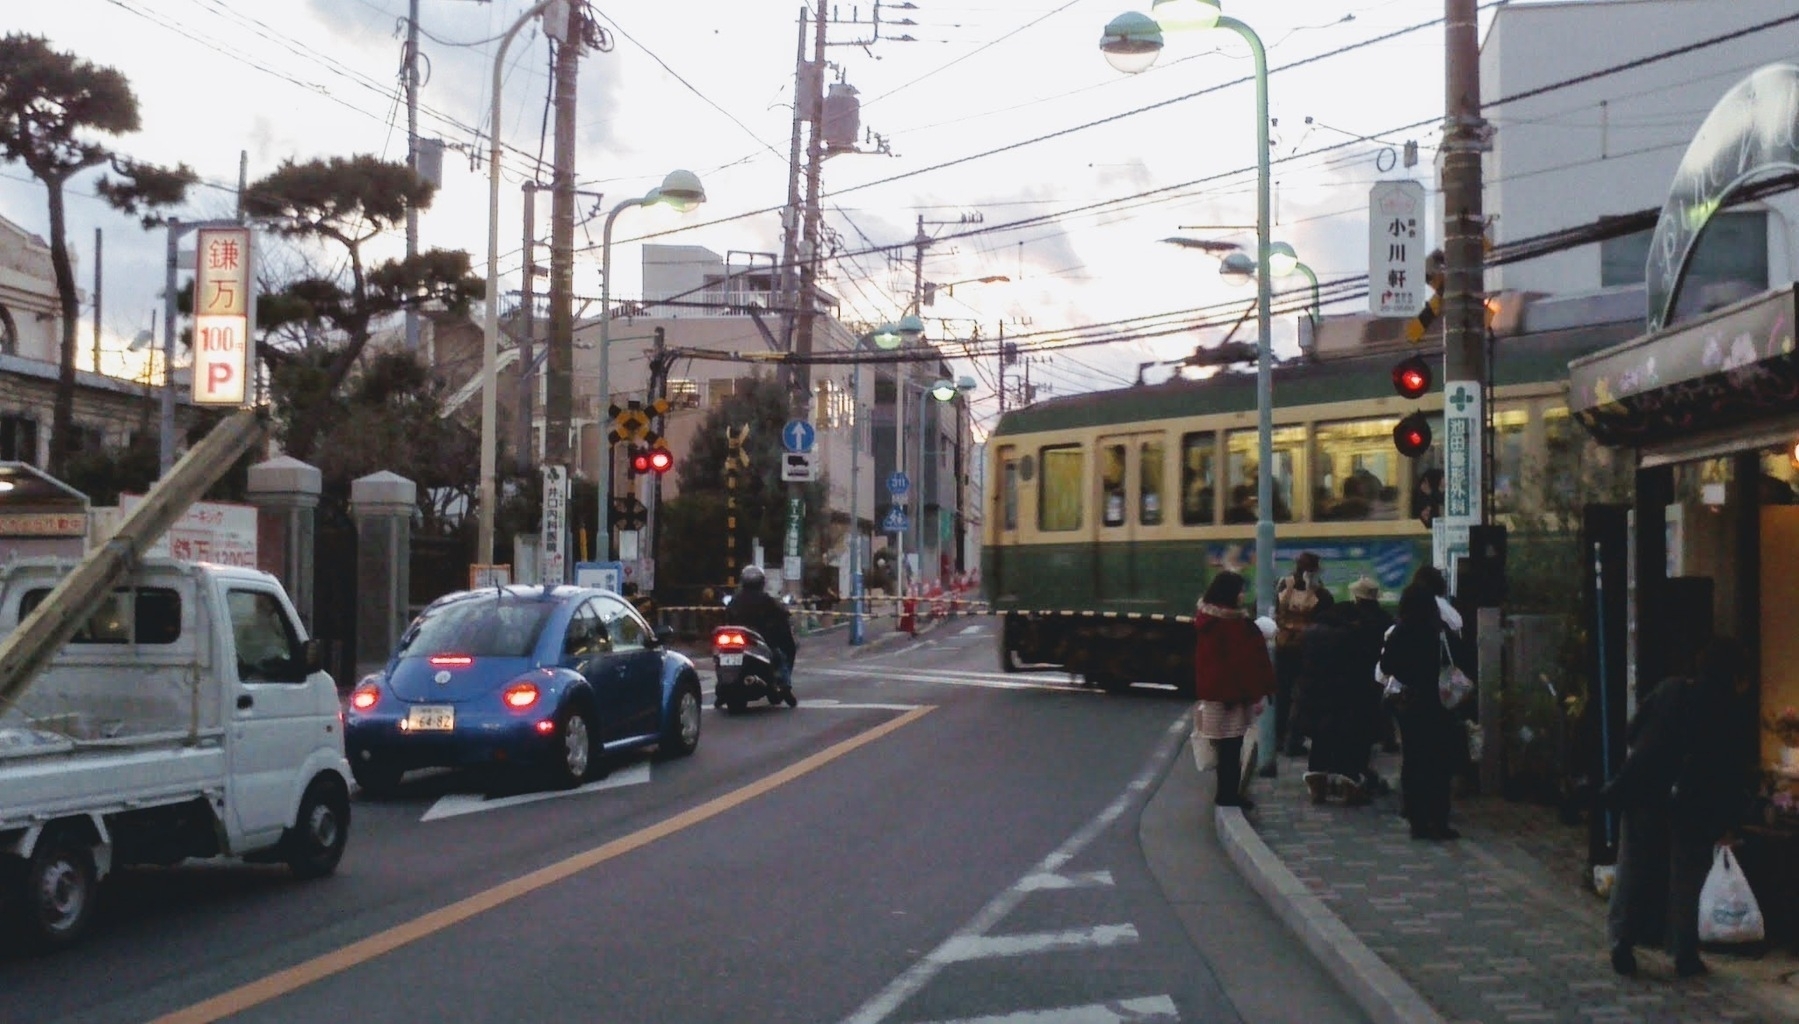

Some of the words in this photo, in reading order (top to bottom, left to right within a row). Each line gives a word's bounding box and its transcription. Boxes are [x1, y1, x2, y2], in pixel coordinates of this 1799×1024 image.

[208, 239, 239, 309] 鎌万
[1387, 218, 1406, 288] 小川軒
[207, 362, 235, 393] P
[892, 478, 906, 488] 311
